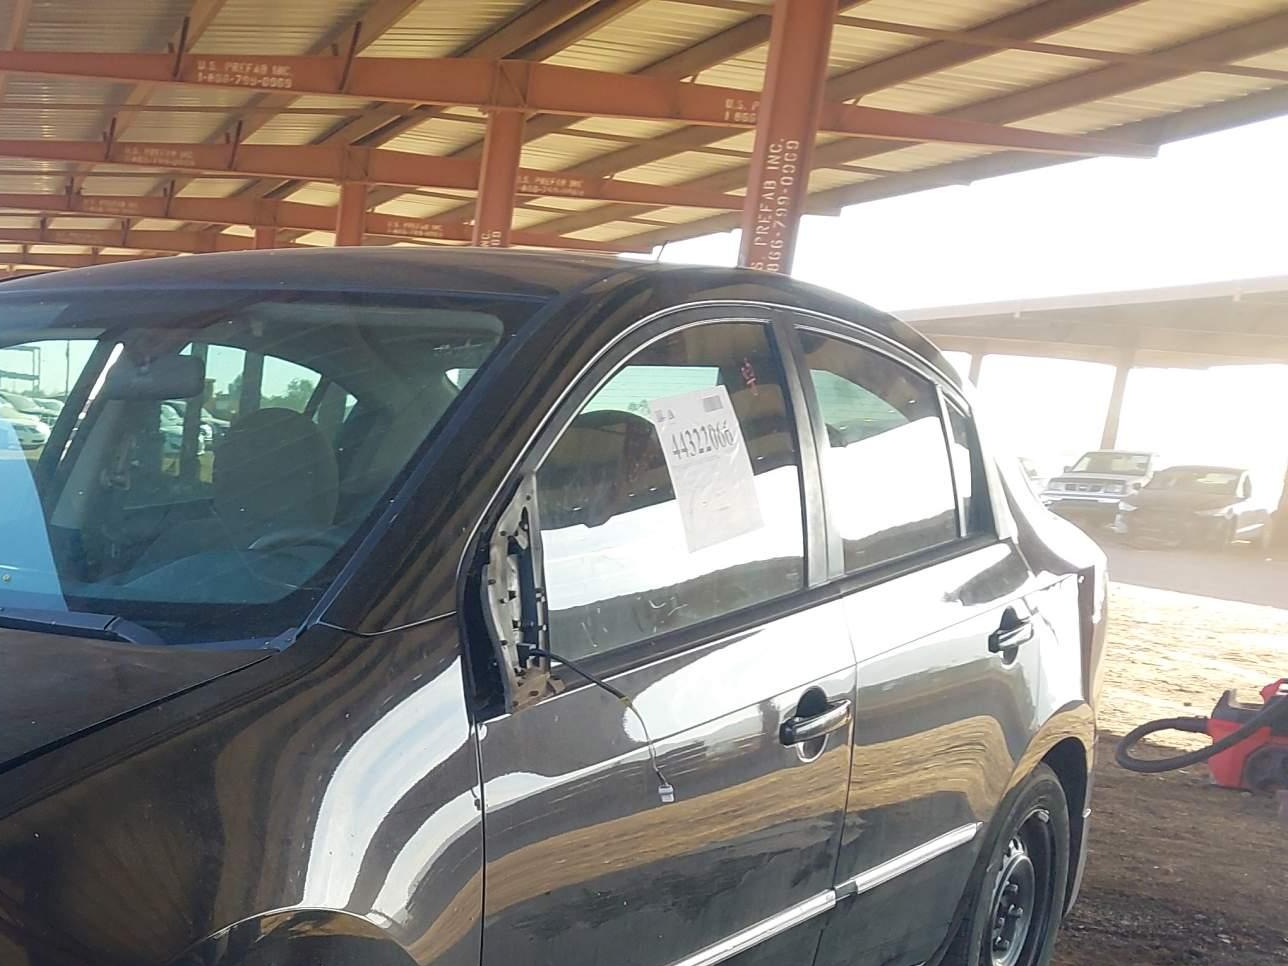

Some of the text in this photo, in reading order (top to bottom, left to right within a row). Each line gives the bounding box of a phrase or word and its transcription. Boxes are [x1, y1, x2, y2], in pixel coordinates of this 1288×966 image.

[753, 180, 777, 246] PREFAB
[766, 138, 785, 170] INC.
[671, 420, 735, 461] 44322066
